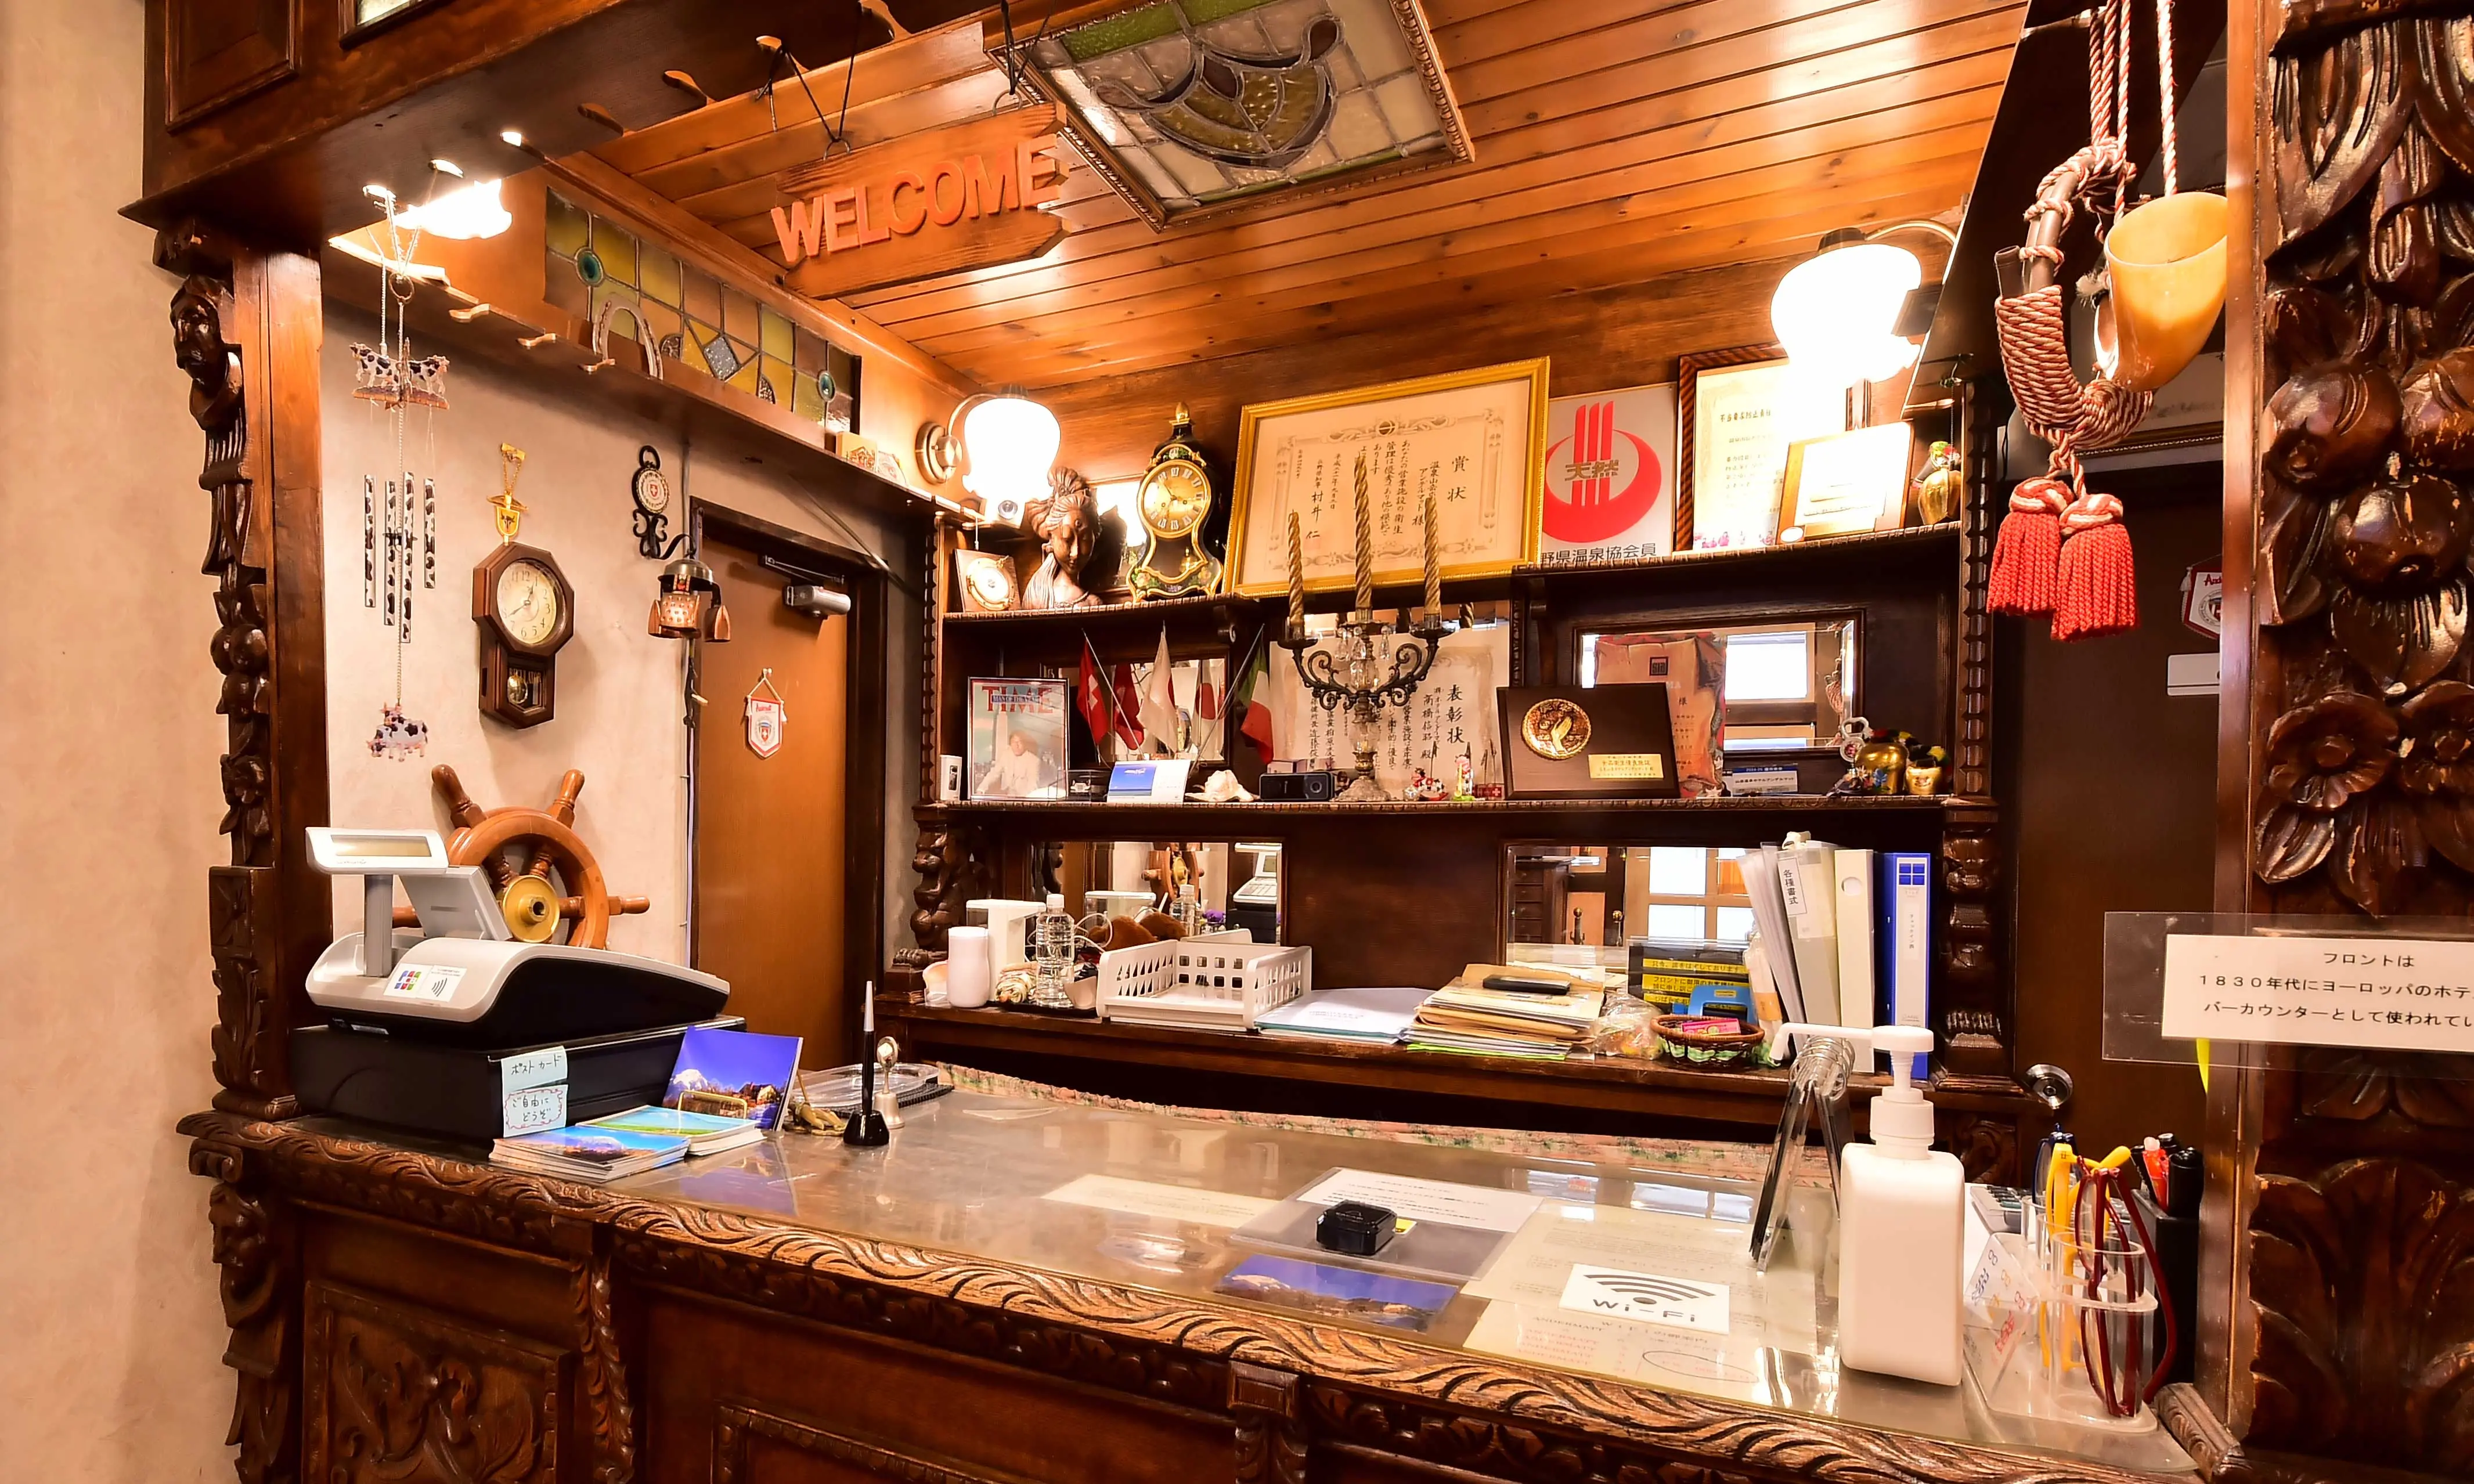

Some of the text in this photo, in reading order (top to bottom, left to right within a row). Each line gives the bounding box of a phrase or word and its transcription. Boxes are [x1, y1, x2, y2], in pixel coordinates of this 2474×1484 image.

[770, 133, 1061, 262] WELCOME
[1447, 456, 1470, 502] 賞状
[1564, 459, 1619, 482] 天然
[982, 685, 1053, 713] TIME
[1446, 684, 1465, 743] 表彰状
[1783, 869, 1799, 905] 各種書式
[2324, 952, 2415, 967] フロントは
[2199, 974, 2474, 999] 1830年代にヨーロッパのホテ
[511, 1053, 562, 1075] ポスト カード
[512, 1095, 549, 1108] ご自由に
[523, 1108, 551, 1122] どうぞ
